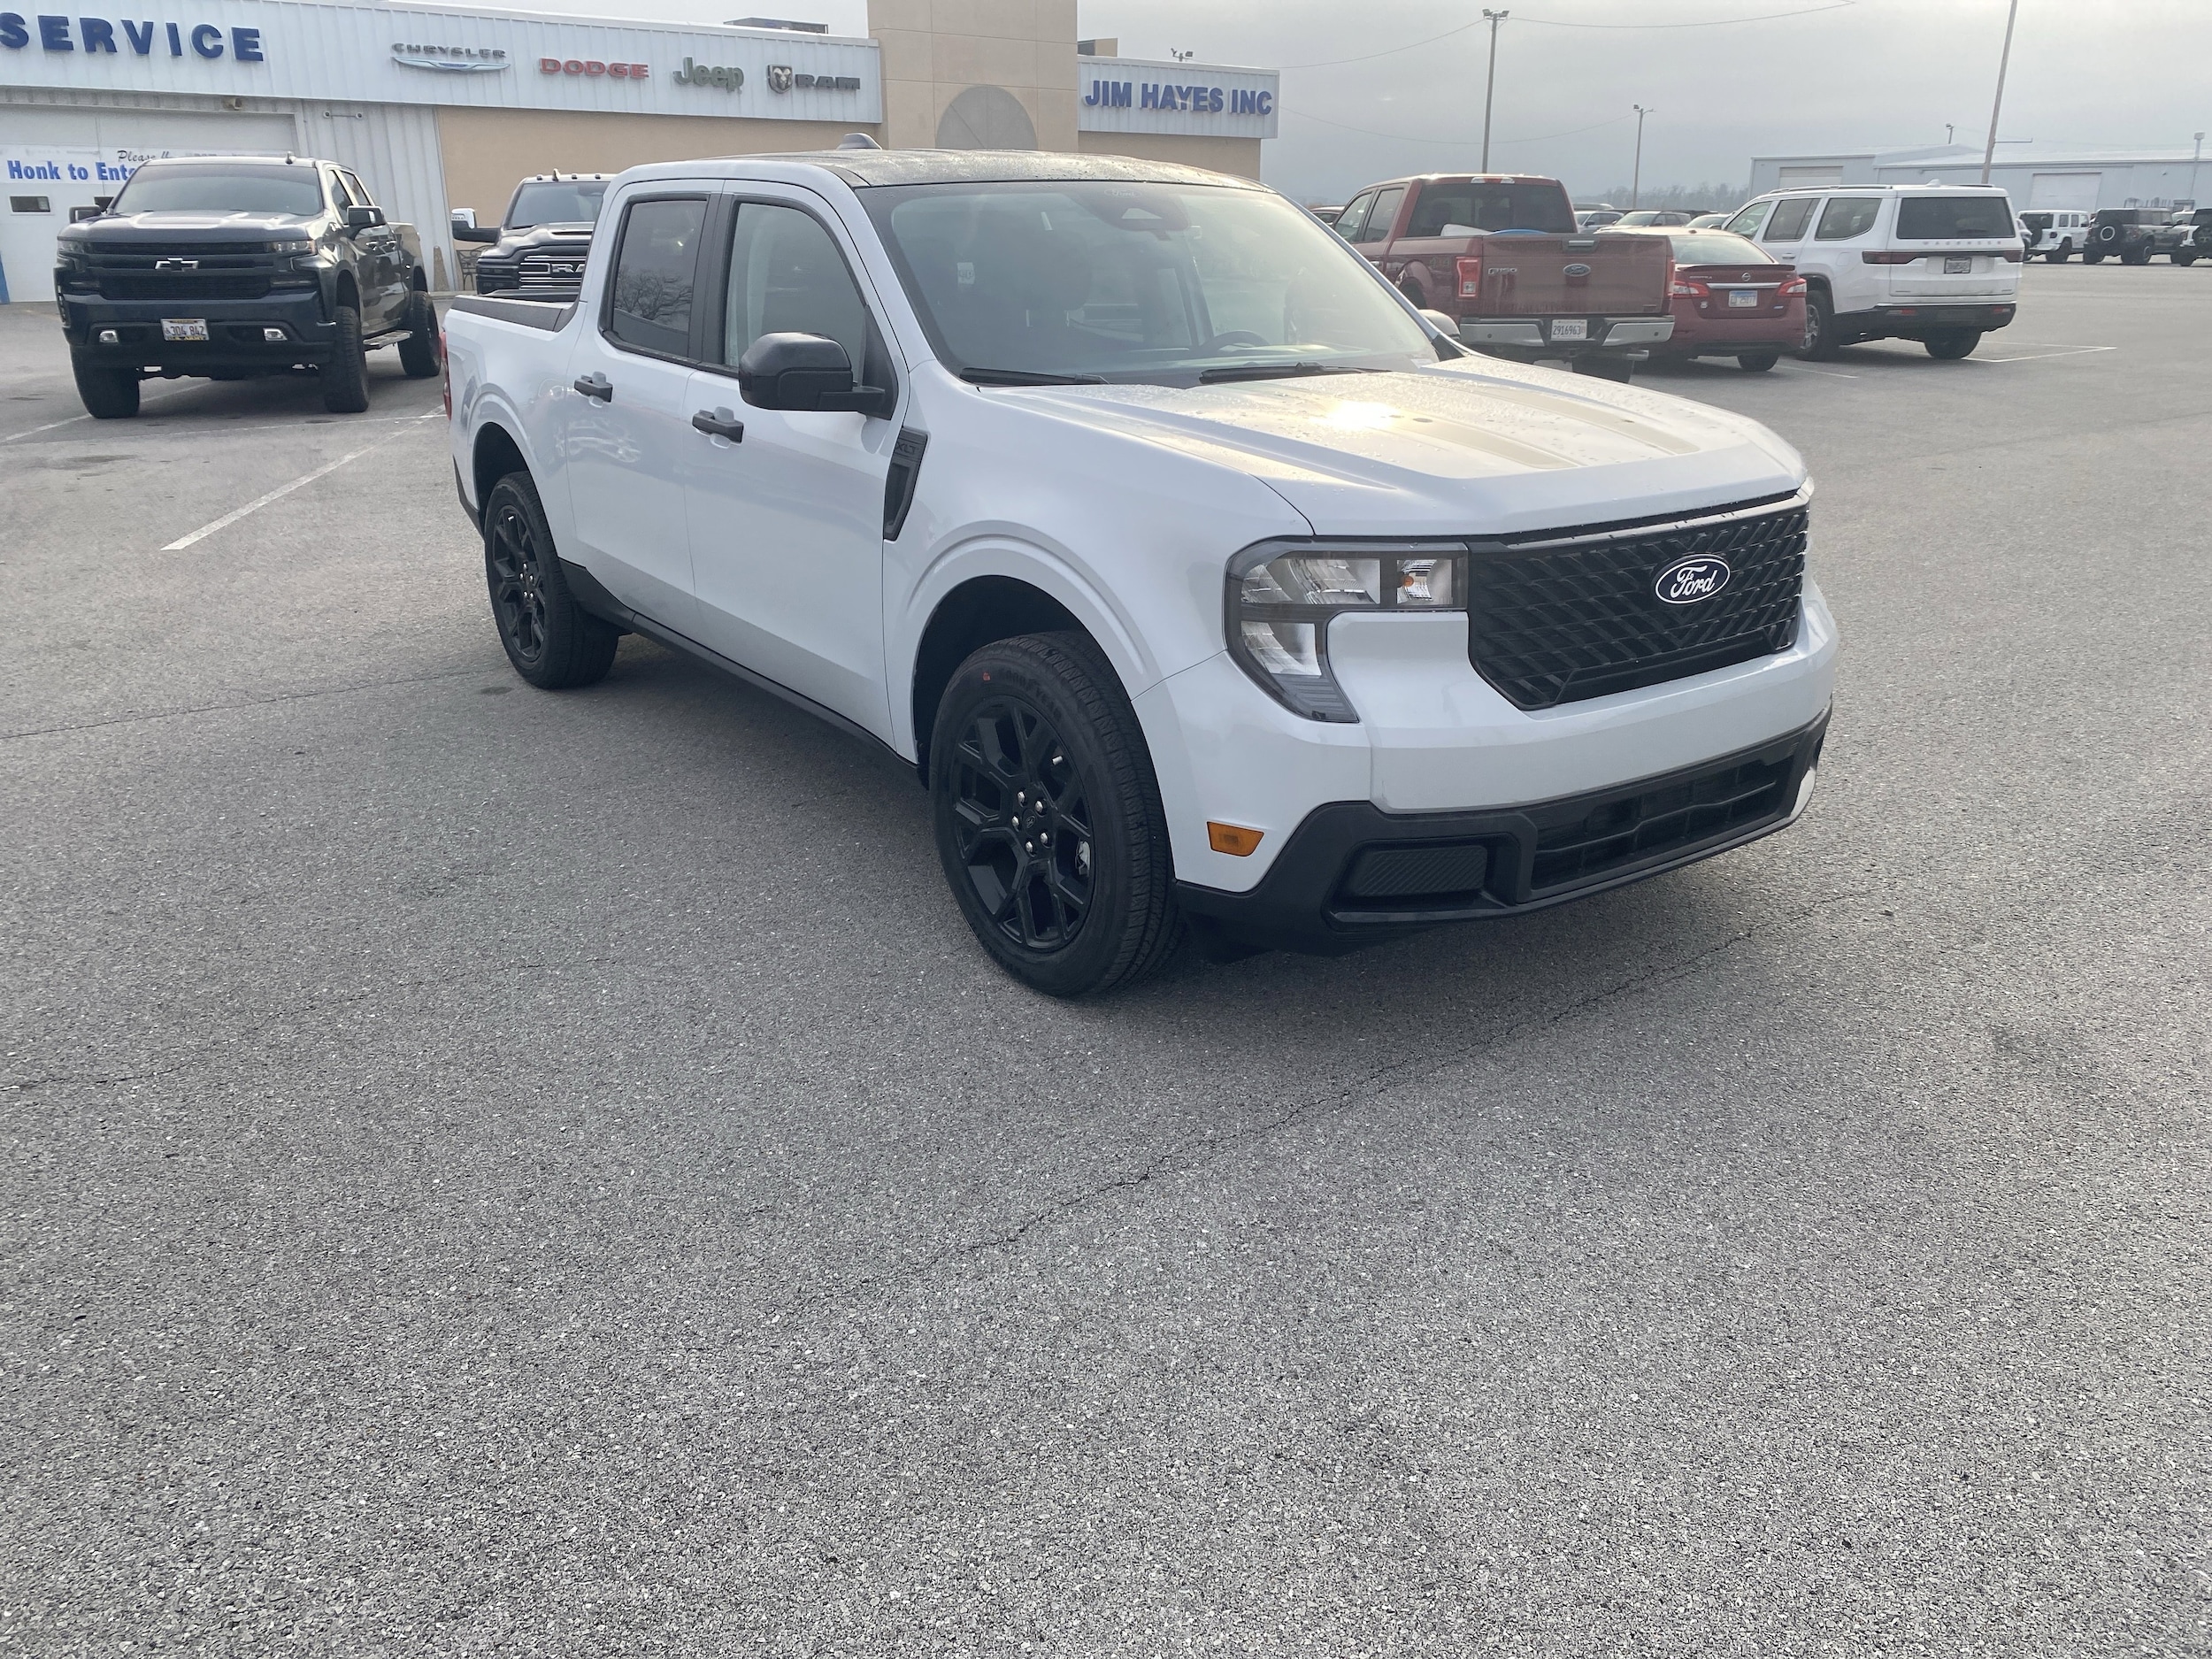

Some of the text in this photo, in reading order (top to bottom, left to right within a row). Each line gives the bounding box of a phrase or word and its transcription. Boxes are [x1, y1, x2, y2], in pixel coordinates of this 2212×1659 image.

[0, 12, 264, 61] SERVICE
[391, 43, 507, 58] CHRYSLER
[540, 58, 649, 79] DODGE
[672, 57, 744, 93] Jeep
[795, 73, 861, 89] RAM
[1084, 80, 1272, 115] JIM HAYES INC
[117, 150, 157, 162] Please
[7, 160, 60, 180] Honk
[68, 163, 88, 180] to
[895, 442, 917, 455] XLT
[1670, 565, 1718, 598] Ford
